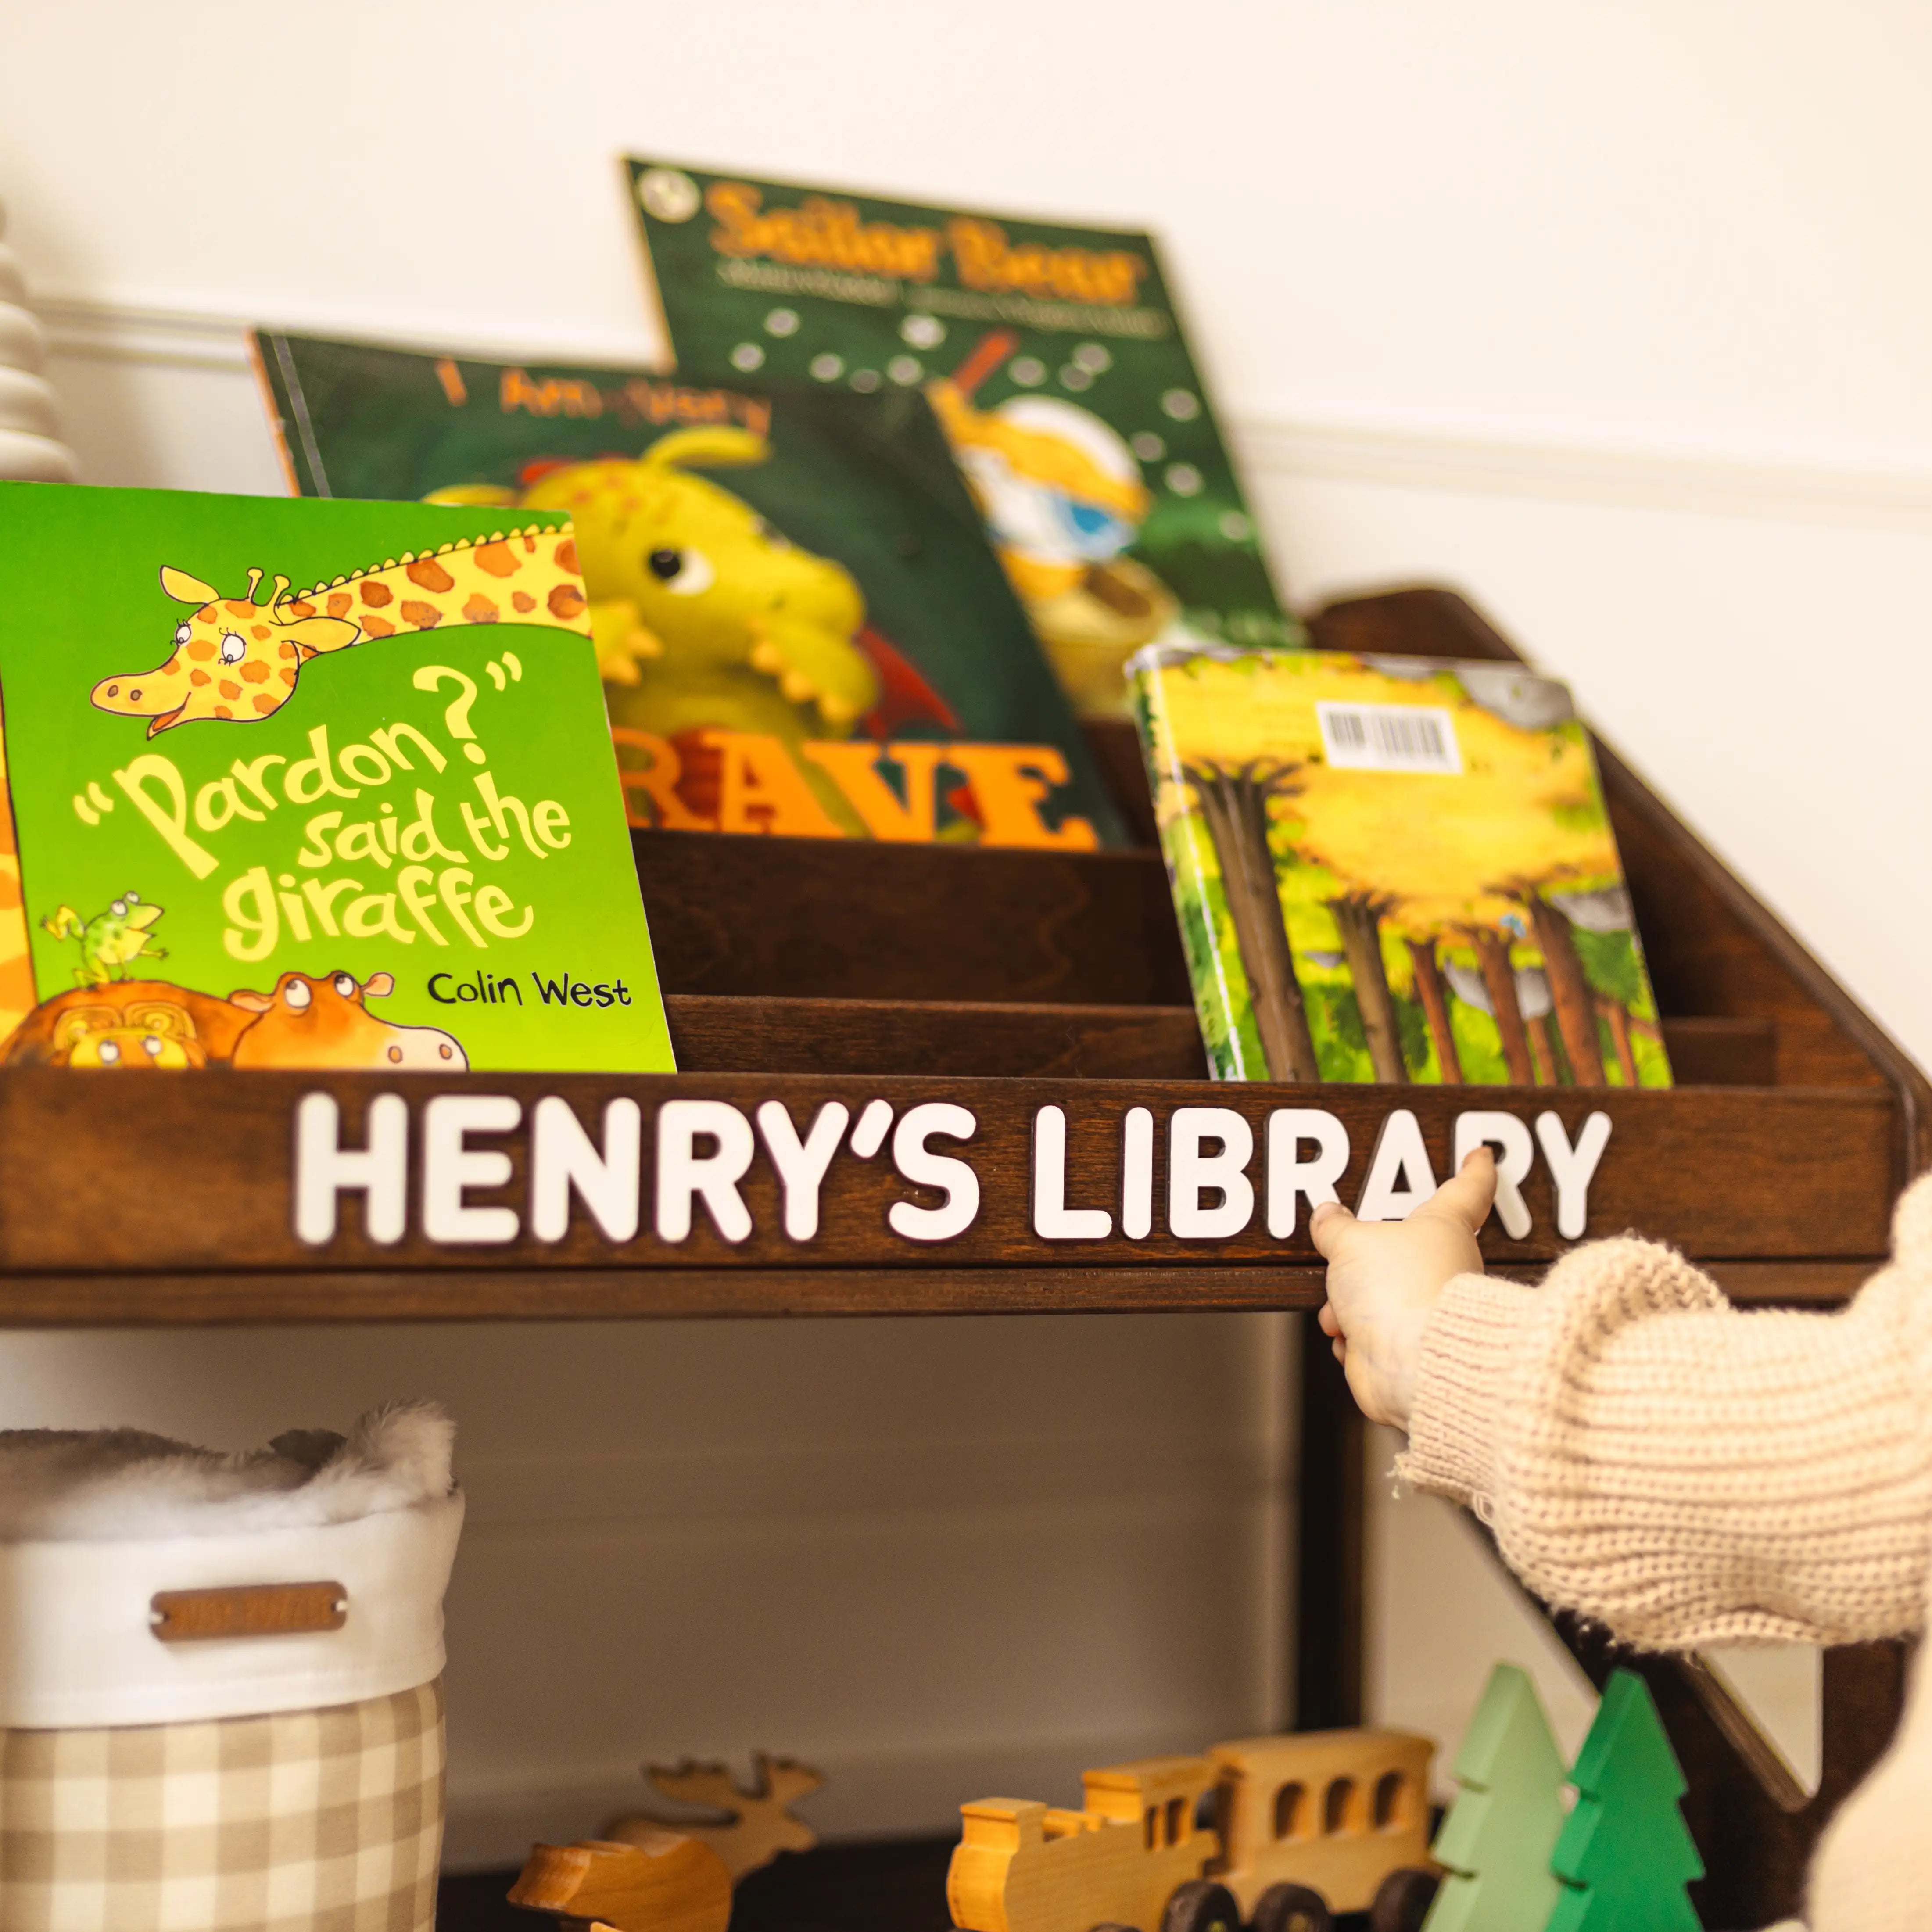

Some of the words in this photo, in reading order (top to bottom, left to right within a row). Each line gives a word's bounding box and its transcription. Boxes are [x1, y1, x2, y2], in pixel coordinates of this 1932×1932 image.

[298, 788, 468, 869] said
[460, 771, 572, 860] the
[611, 726, 1100, 852] RAVE
[222, 865, 534, 962] giraffe
[427, 969, 522, 1006] Colin
[533, 971, 634, 1009] West
[293, 1091, 979, 1244] HENRY'S
[1031, 1104, 1614, 1241] LIBRARY
